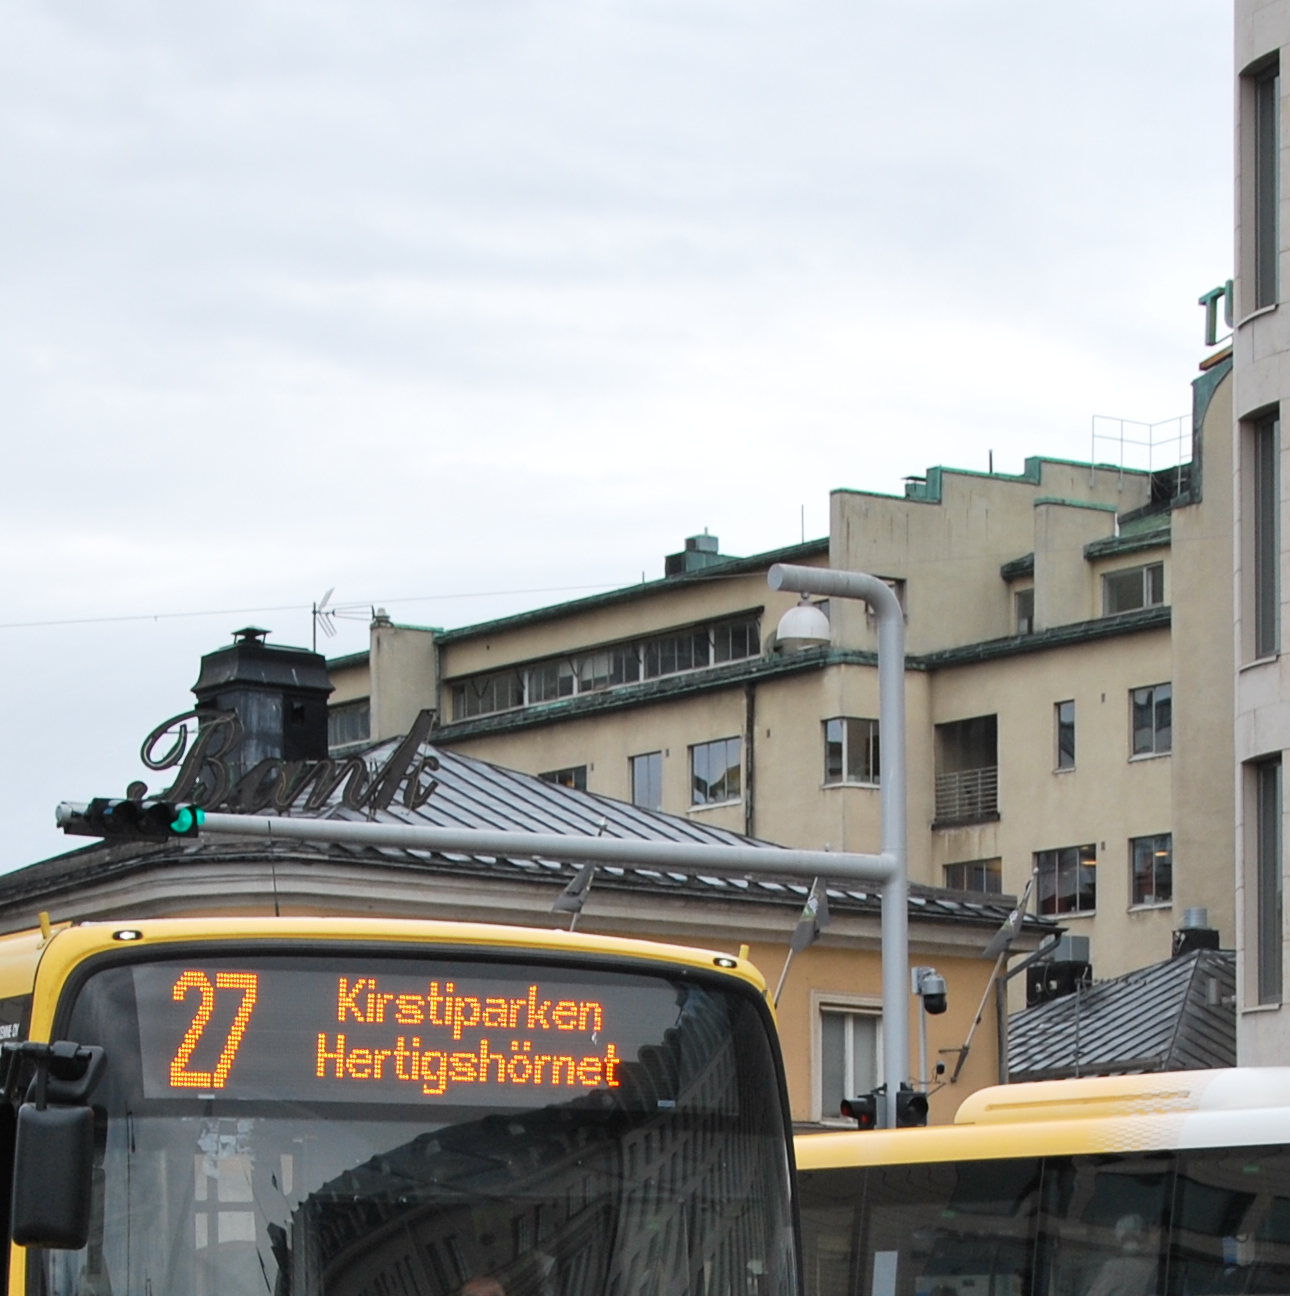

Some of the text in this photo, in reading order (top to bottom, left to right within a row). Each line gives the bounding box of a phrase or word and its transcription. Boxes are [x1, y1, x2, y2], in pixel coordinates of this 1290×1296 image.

[127, 707, 441, 820] Bank
[170, 970, 258, 1089] 27
[337, 977, 602, 1040] Kirstiparken
[316, 1032, 620, 1095] Hertigshörnet
